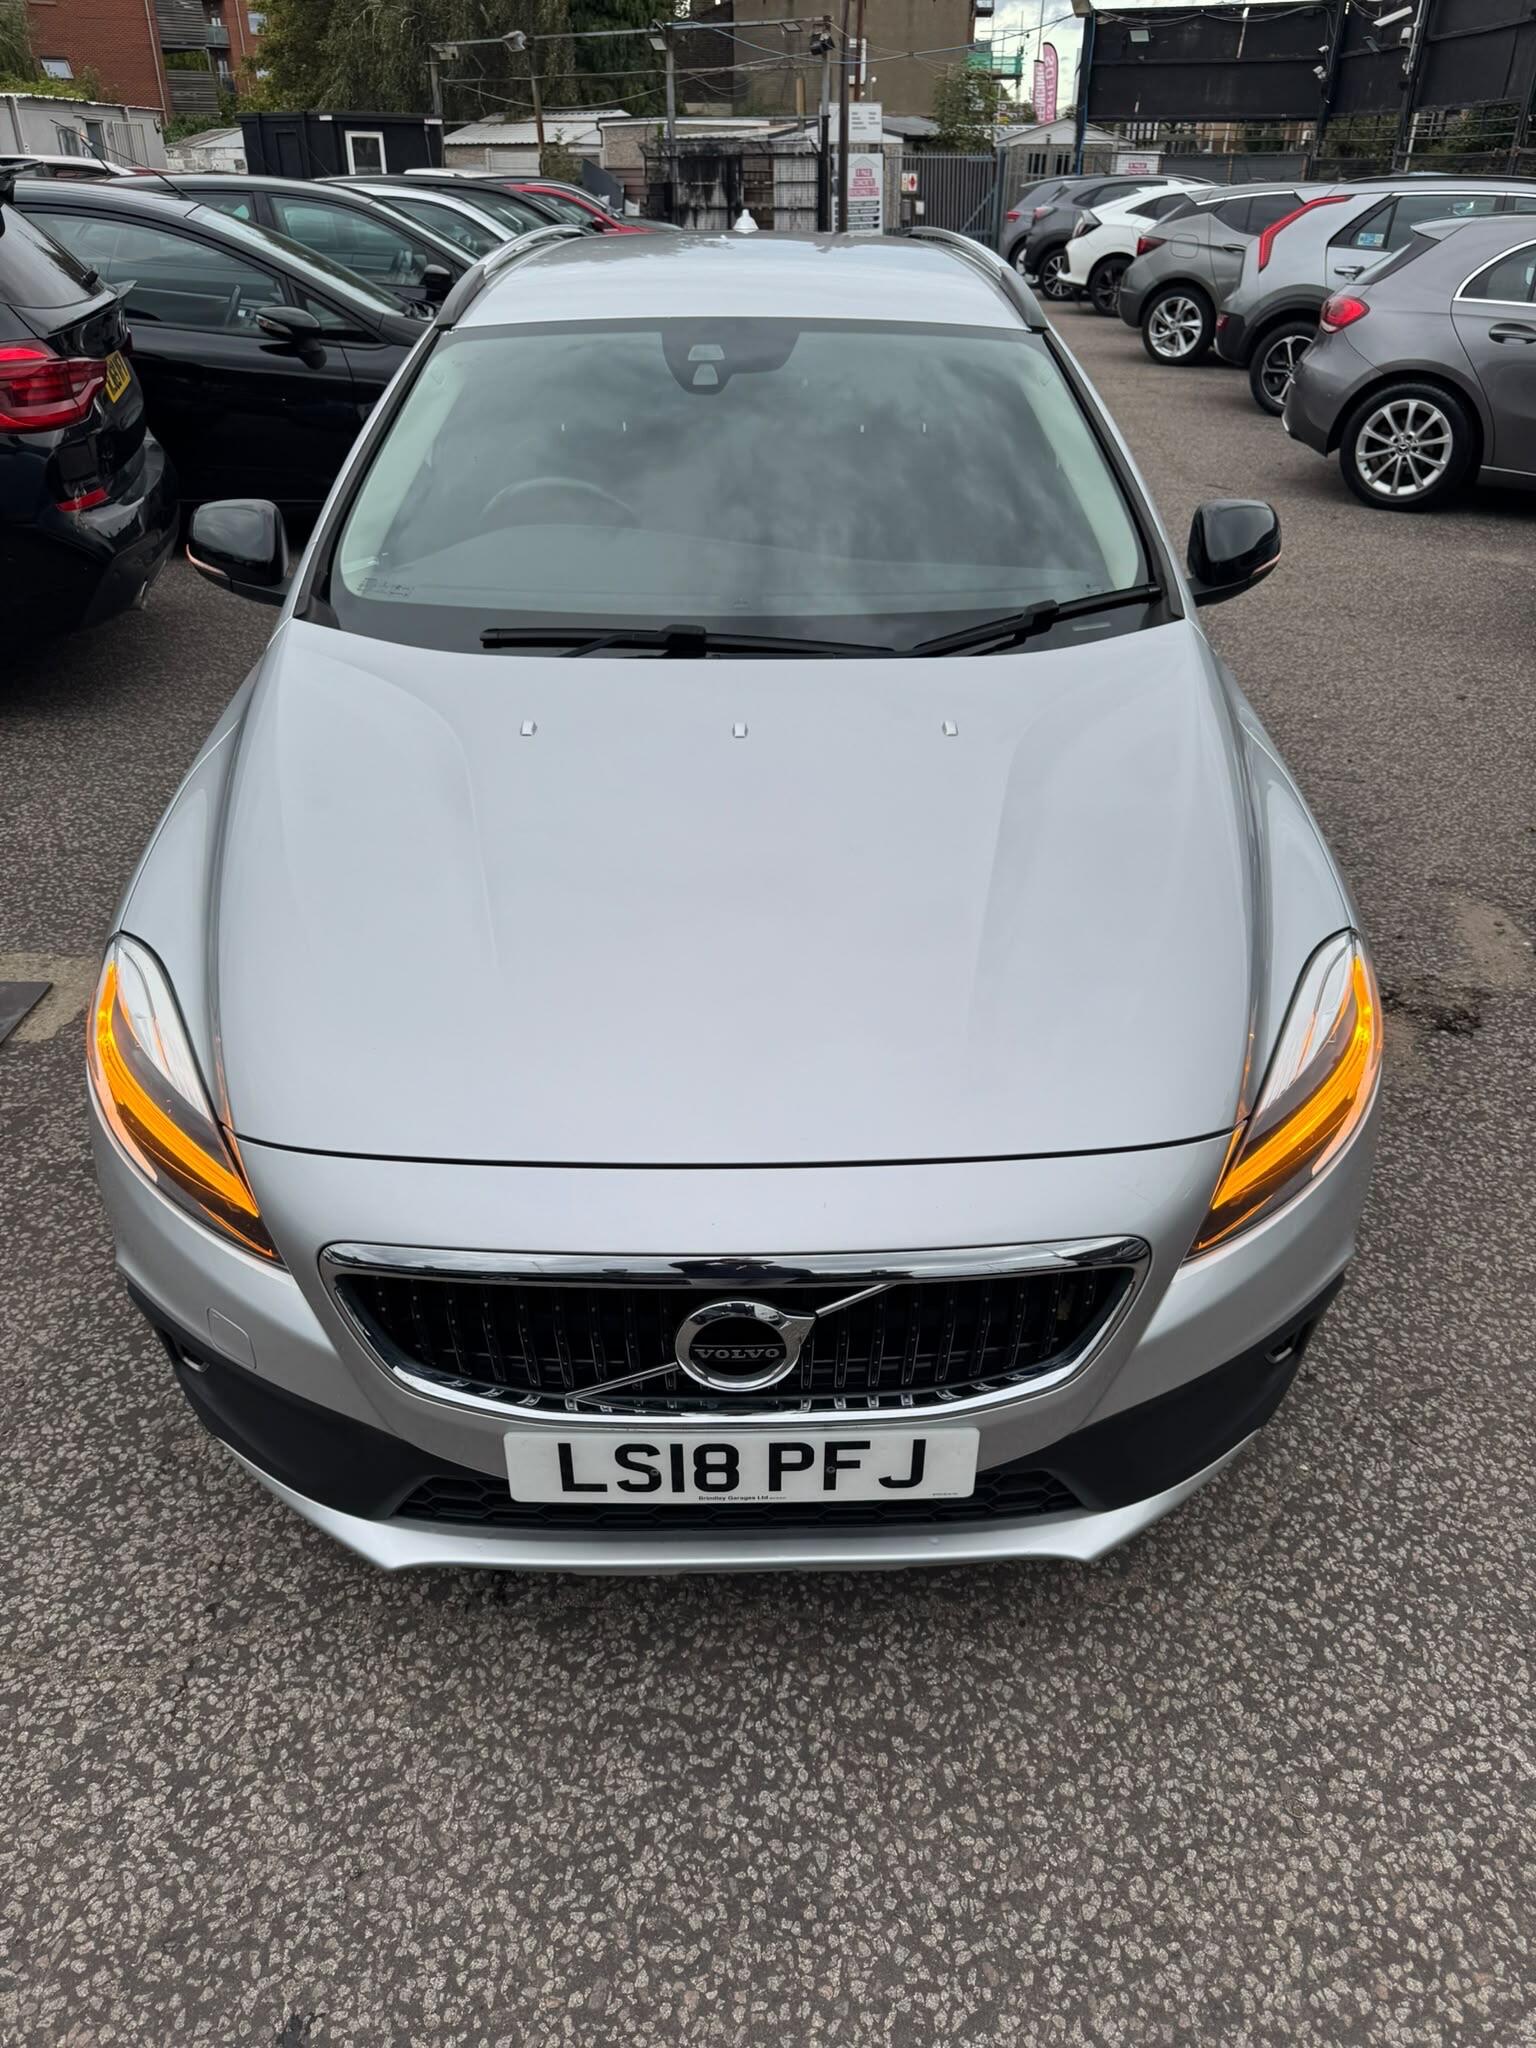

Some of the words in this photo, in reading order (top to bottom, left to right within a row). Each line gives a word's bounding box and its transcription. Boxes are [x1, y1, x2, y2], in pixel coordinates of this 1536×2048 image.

[694, 1348, 780, 1359] VOLVO
[557, 1441, 740, 1494] LS18
[768, 1438, 927, 1492] PFJ
